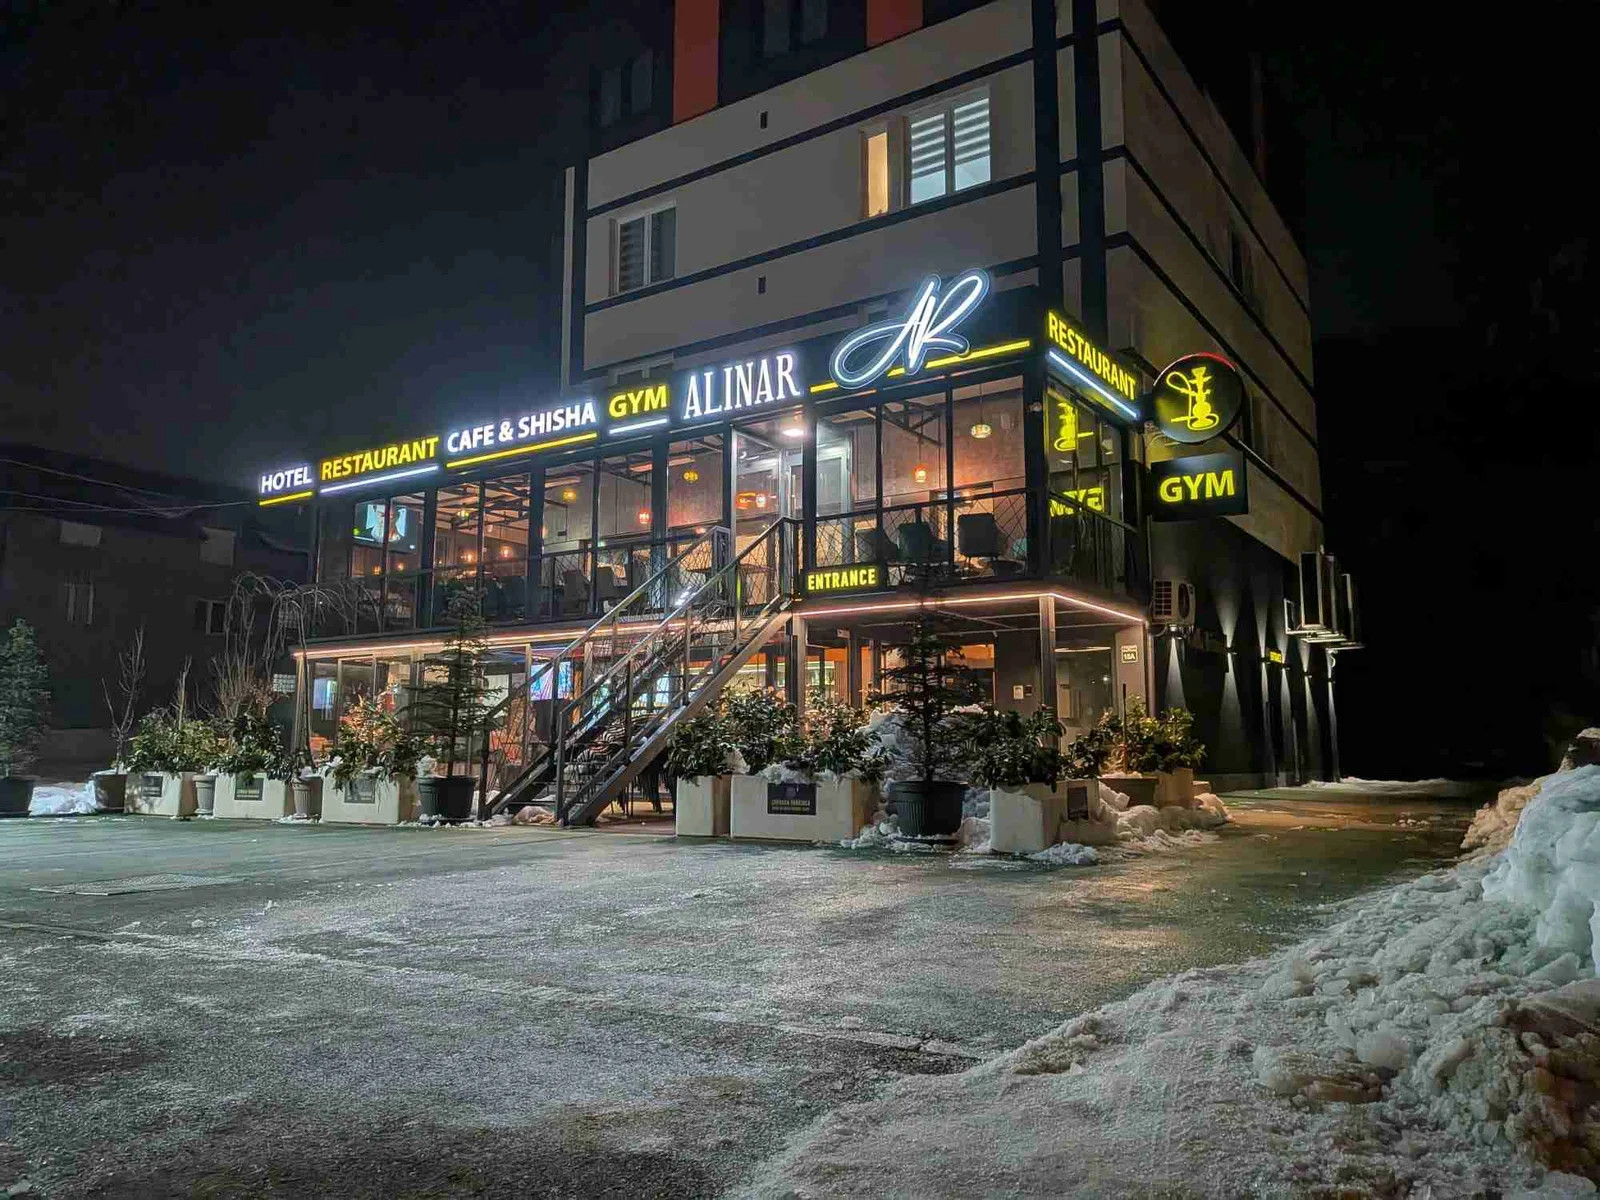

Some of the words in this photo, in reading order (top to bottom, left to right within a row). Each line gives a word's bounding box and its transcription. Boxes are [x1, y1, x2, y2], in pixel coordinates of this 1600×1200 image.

[1047, 311, 1137, 401] RESTAURANT
[608, 385, 669, 418] GYM
[682, 353, 800, 420] ALINAR
[446, 421, 494, 453] CAFE
[498, 420, 514, 441] &
[518, 402, 597, 439] SHISHA
[320, 437, 440, 481] RESTAURANT
[261, 466, 312, 493] HOTEL
[1159, 470, 1236, 502] GYM
[807, 568, 876, 590] ENTRANCE
